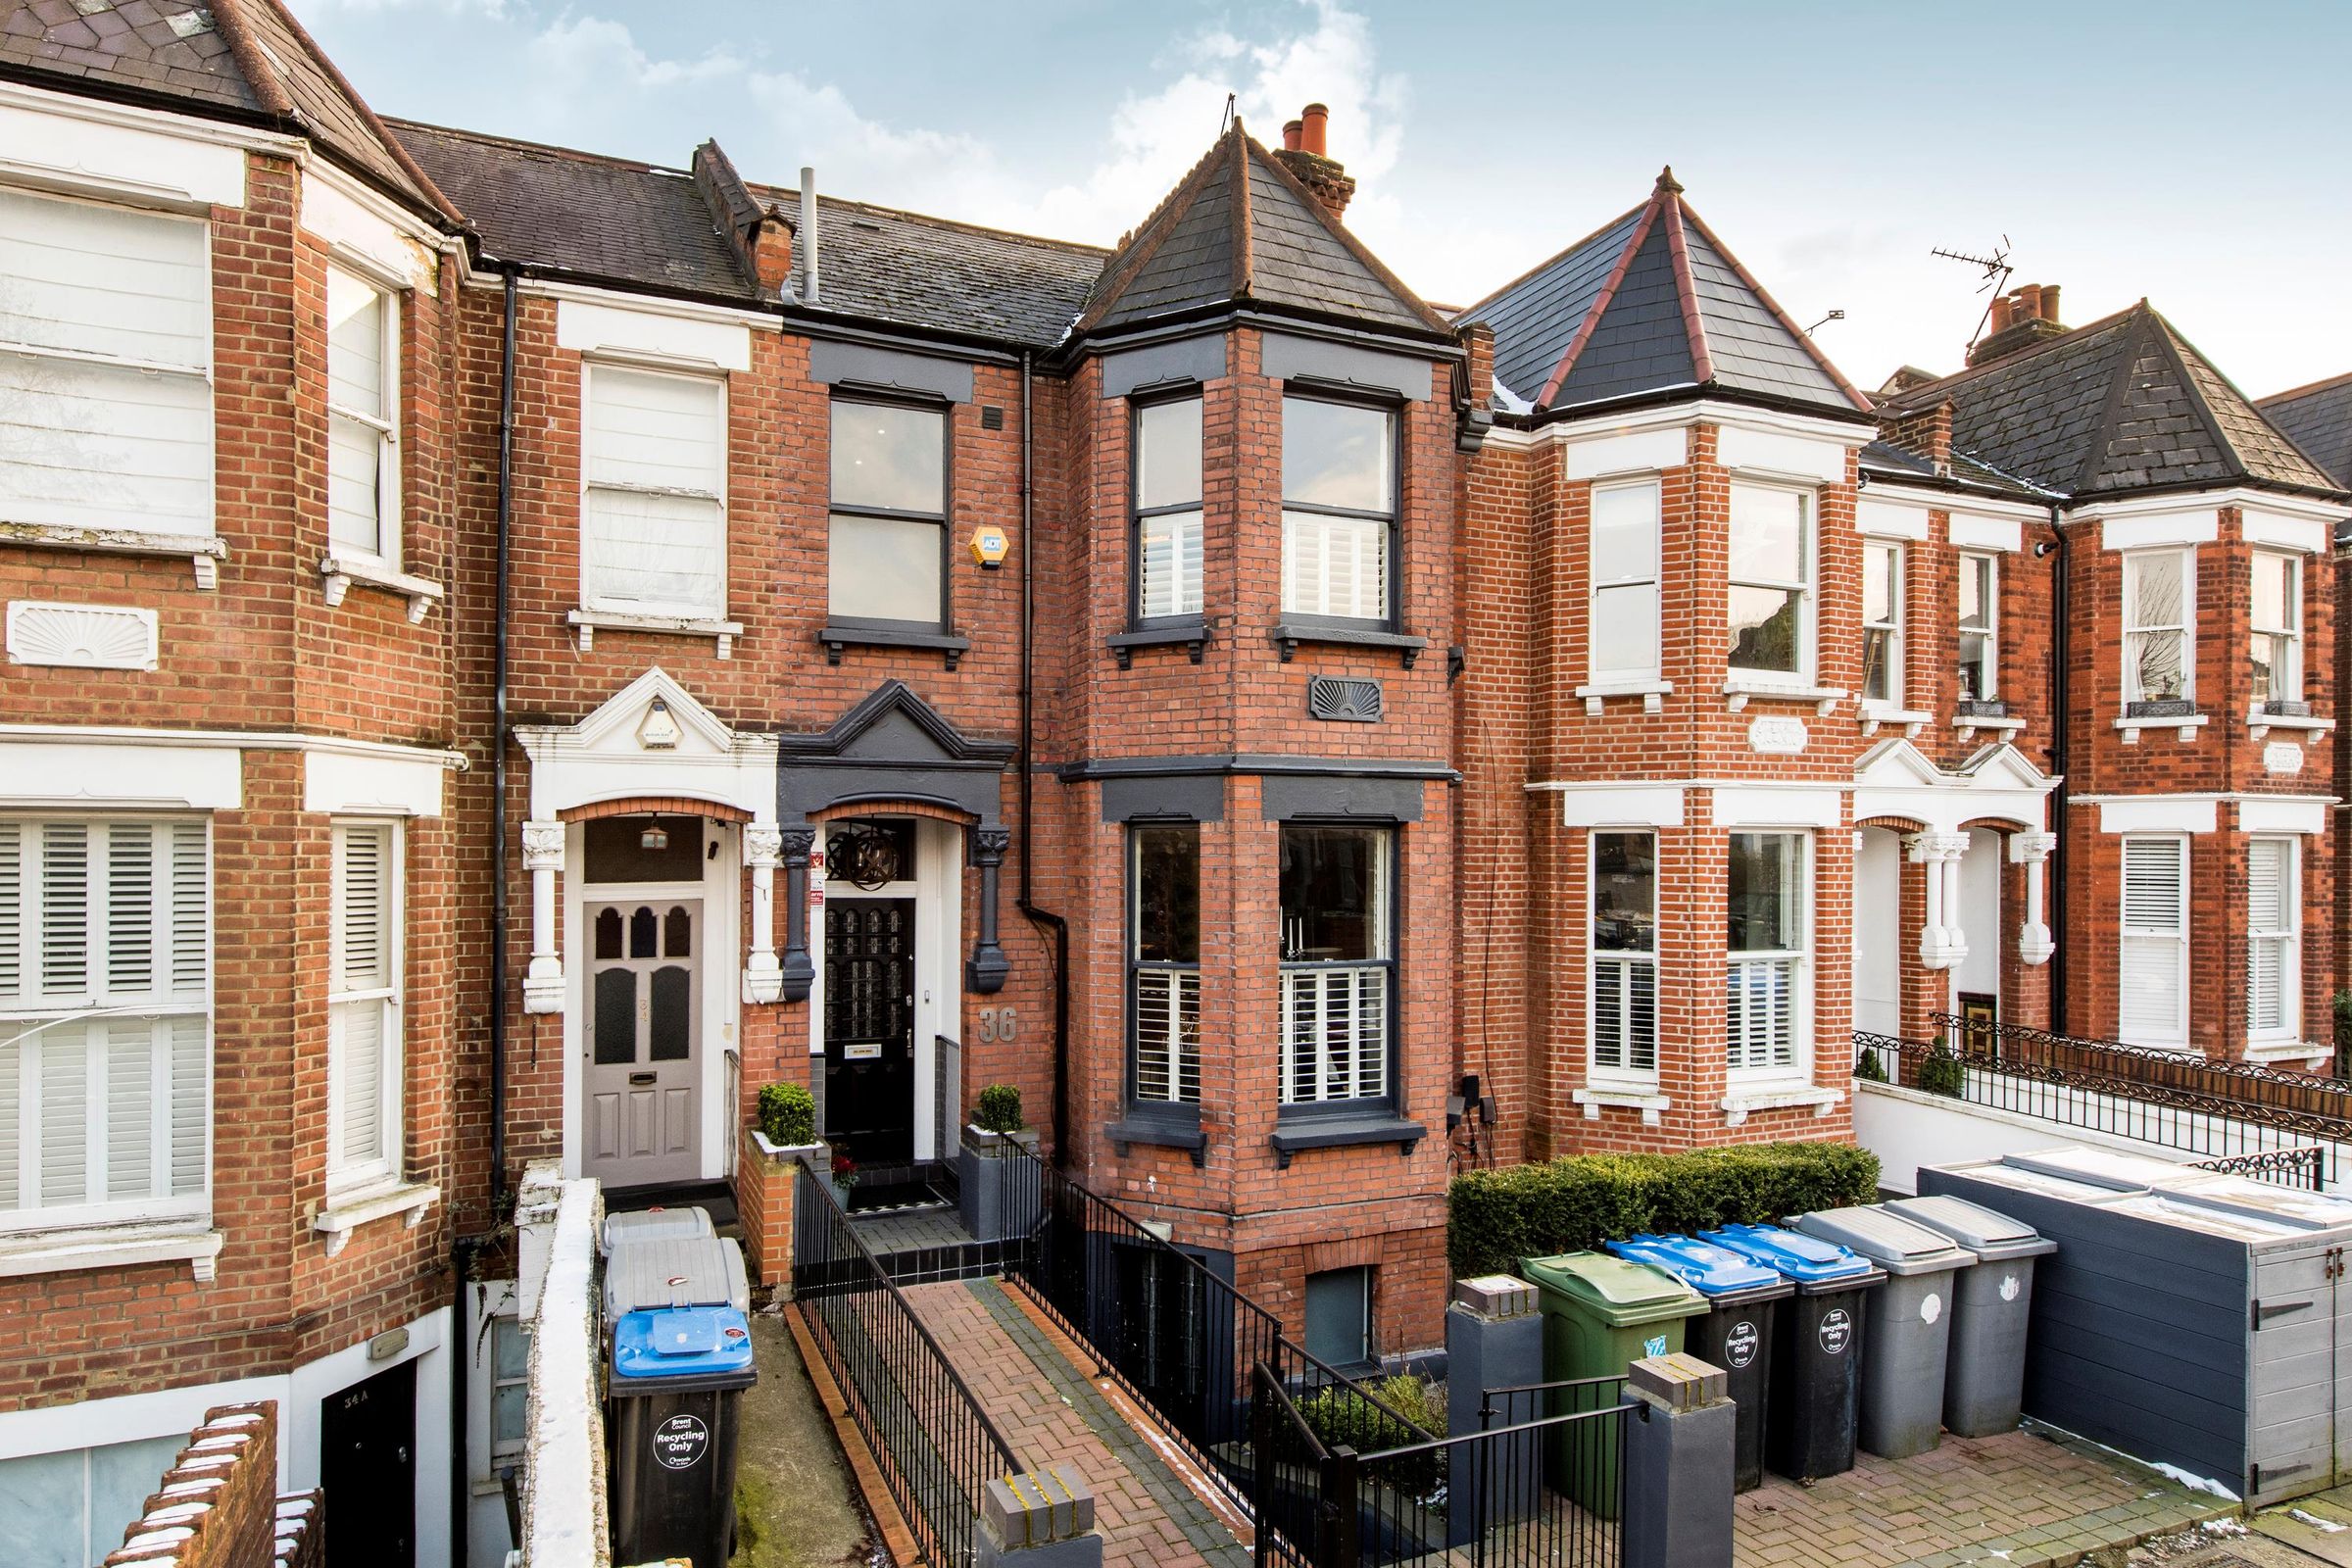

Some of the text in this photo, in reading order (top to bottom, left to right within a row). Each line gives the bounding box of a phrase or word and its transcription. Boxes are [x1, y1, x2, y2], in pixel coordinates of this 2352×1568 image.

[983, 538, 1001, 549] ADT
[979, 1007, 1017, 1043] 36
[1822, 1322, 1849, 1333] Recycling
[1728, 1335, 1756, 1347] Recycling
[1828, 1331, 1842, 1340] Only
[1735, 1344, 1749, 1353] Only
[657, 1431, 706, 1443] Recycling
[668, 1441, 693, 1452] Only
